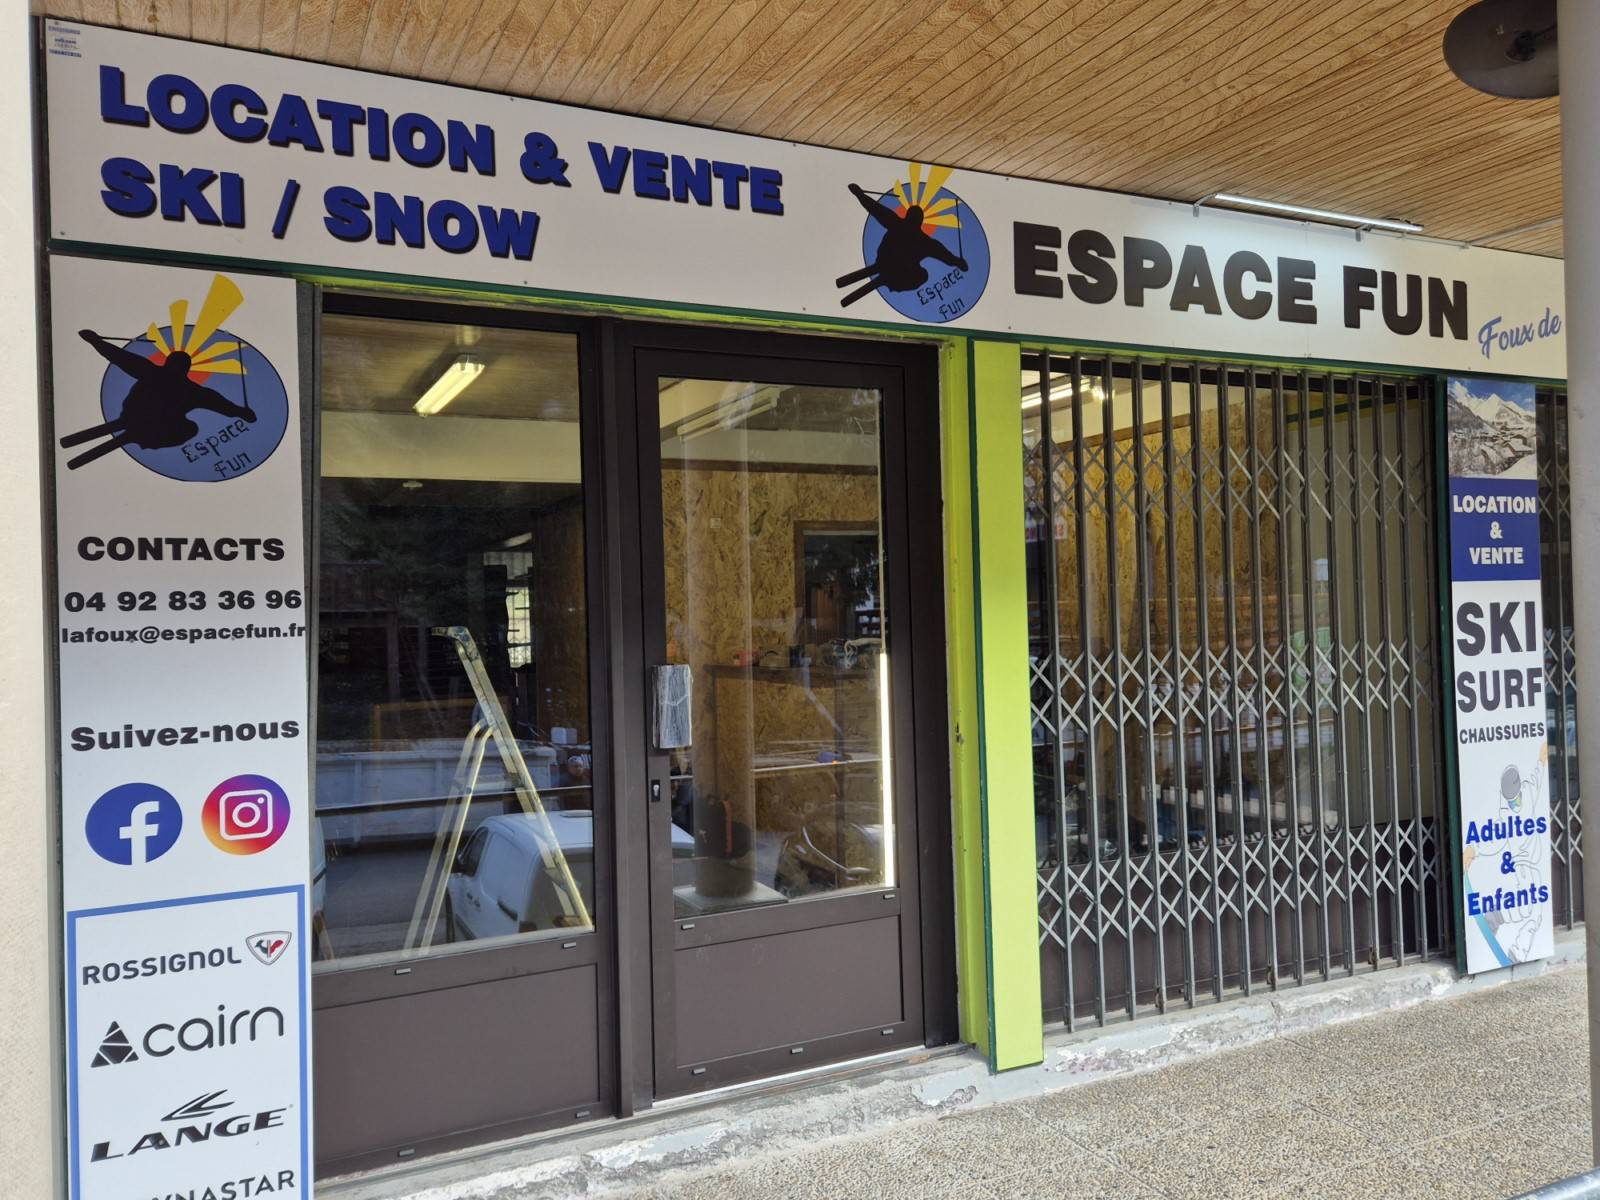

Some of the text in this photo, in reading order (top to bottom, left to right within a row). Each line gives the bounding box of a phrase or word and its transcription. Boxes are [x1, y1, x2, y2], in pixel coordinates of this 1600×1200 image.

[99, 65, 785, 215] LOCATION & VENTE
[100, 157, 541, 261] SKI / SNOW
[917, 267, 965, 306] Espace
[1013, 220, 1469, 341] ESPACE FUN
[938, 297, 966, 321] Fun
[1477, 307, 1562, 360] Foux de
[180, 419, 250, 463] Espace
[214, 452, 252, 479] Fun
[1453, 495, 1537, 514] LOCATION
[1489, 521, 1503, 540] &
[77, 536, 285, 561] CONTACTS
[1469, 547, 1525, 565] VENTE
[64, 590, 302, 612] 04 92 83 36 96
[62, 622, 306, 643] lafoux@espacefun.fr
[1456, 601, 1537, 657] SKI
[1457, 667, 1543, 713] SURF
[70, 720, 300, 752] Suivez-nous
[1459, 722, 1545, 744] CHAUSSURES
[1465, 815, 1547, 845] Adultes
[1500, 851, 1516, 874] &
[1467, 883, 1549, 916] Enfants
[82, 946, 242, 985] ROSSIGNOL
[143, 1004, 284, 1057] cairn
[90, 1107, 288, 1162] LANGE
